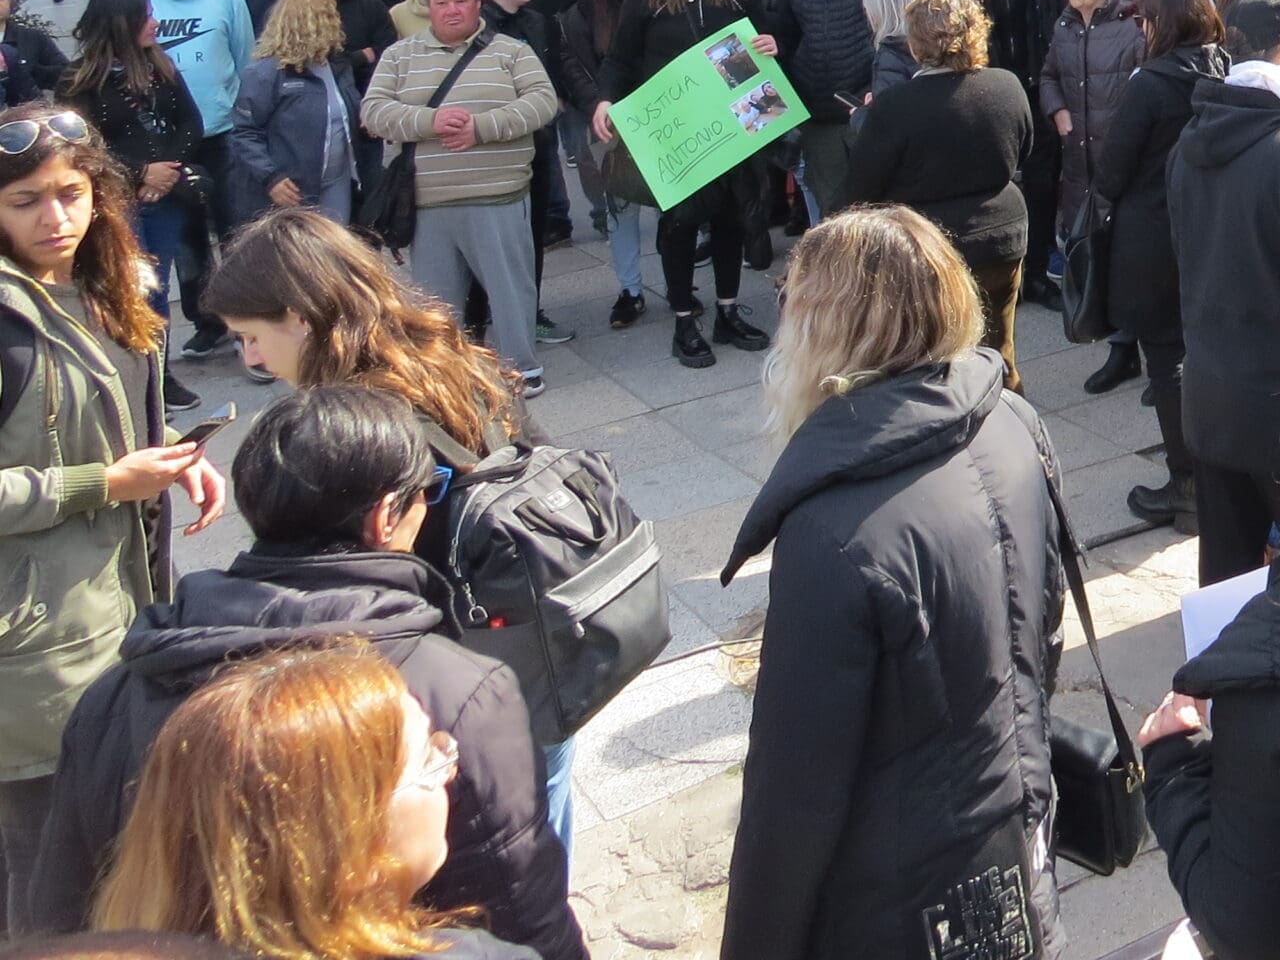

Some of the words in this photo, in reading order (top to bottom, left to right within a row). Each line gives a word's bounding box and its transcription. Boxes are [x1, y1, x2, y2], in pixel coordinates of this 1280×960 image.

[156, 18, 202, 37] NIKE
[626, 75, 700, 133] JUSTICIA
[650, 117, 686, 144] POR
[657, 119, 724, 183] ANTONIO
